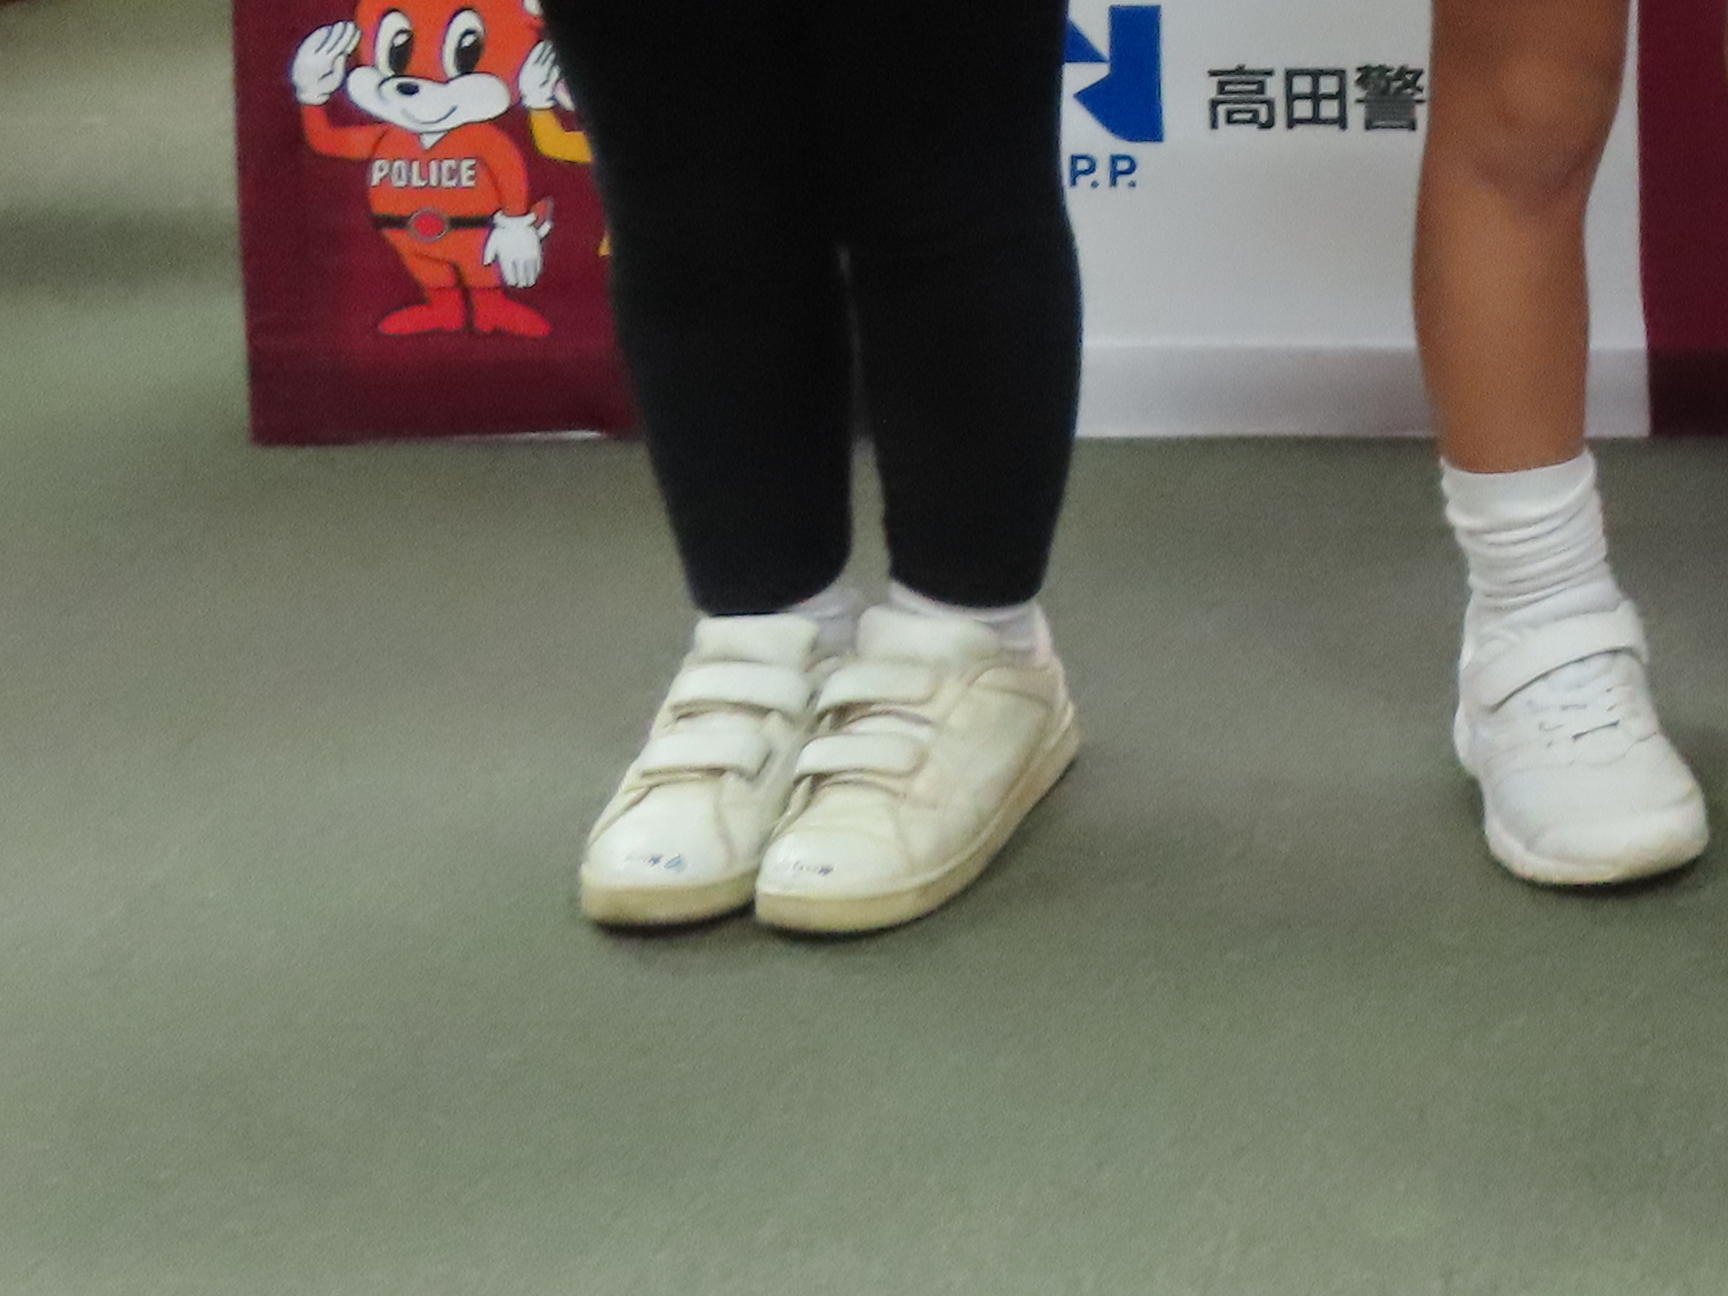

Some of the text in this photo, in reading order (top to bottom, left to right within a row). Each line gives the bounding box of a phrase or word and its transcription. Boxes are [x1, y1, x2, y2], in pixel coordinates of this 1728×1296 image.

[1206, 62, 1425, 134] 高田警
[370, 158, 478, 188] POLICE
